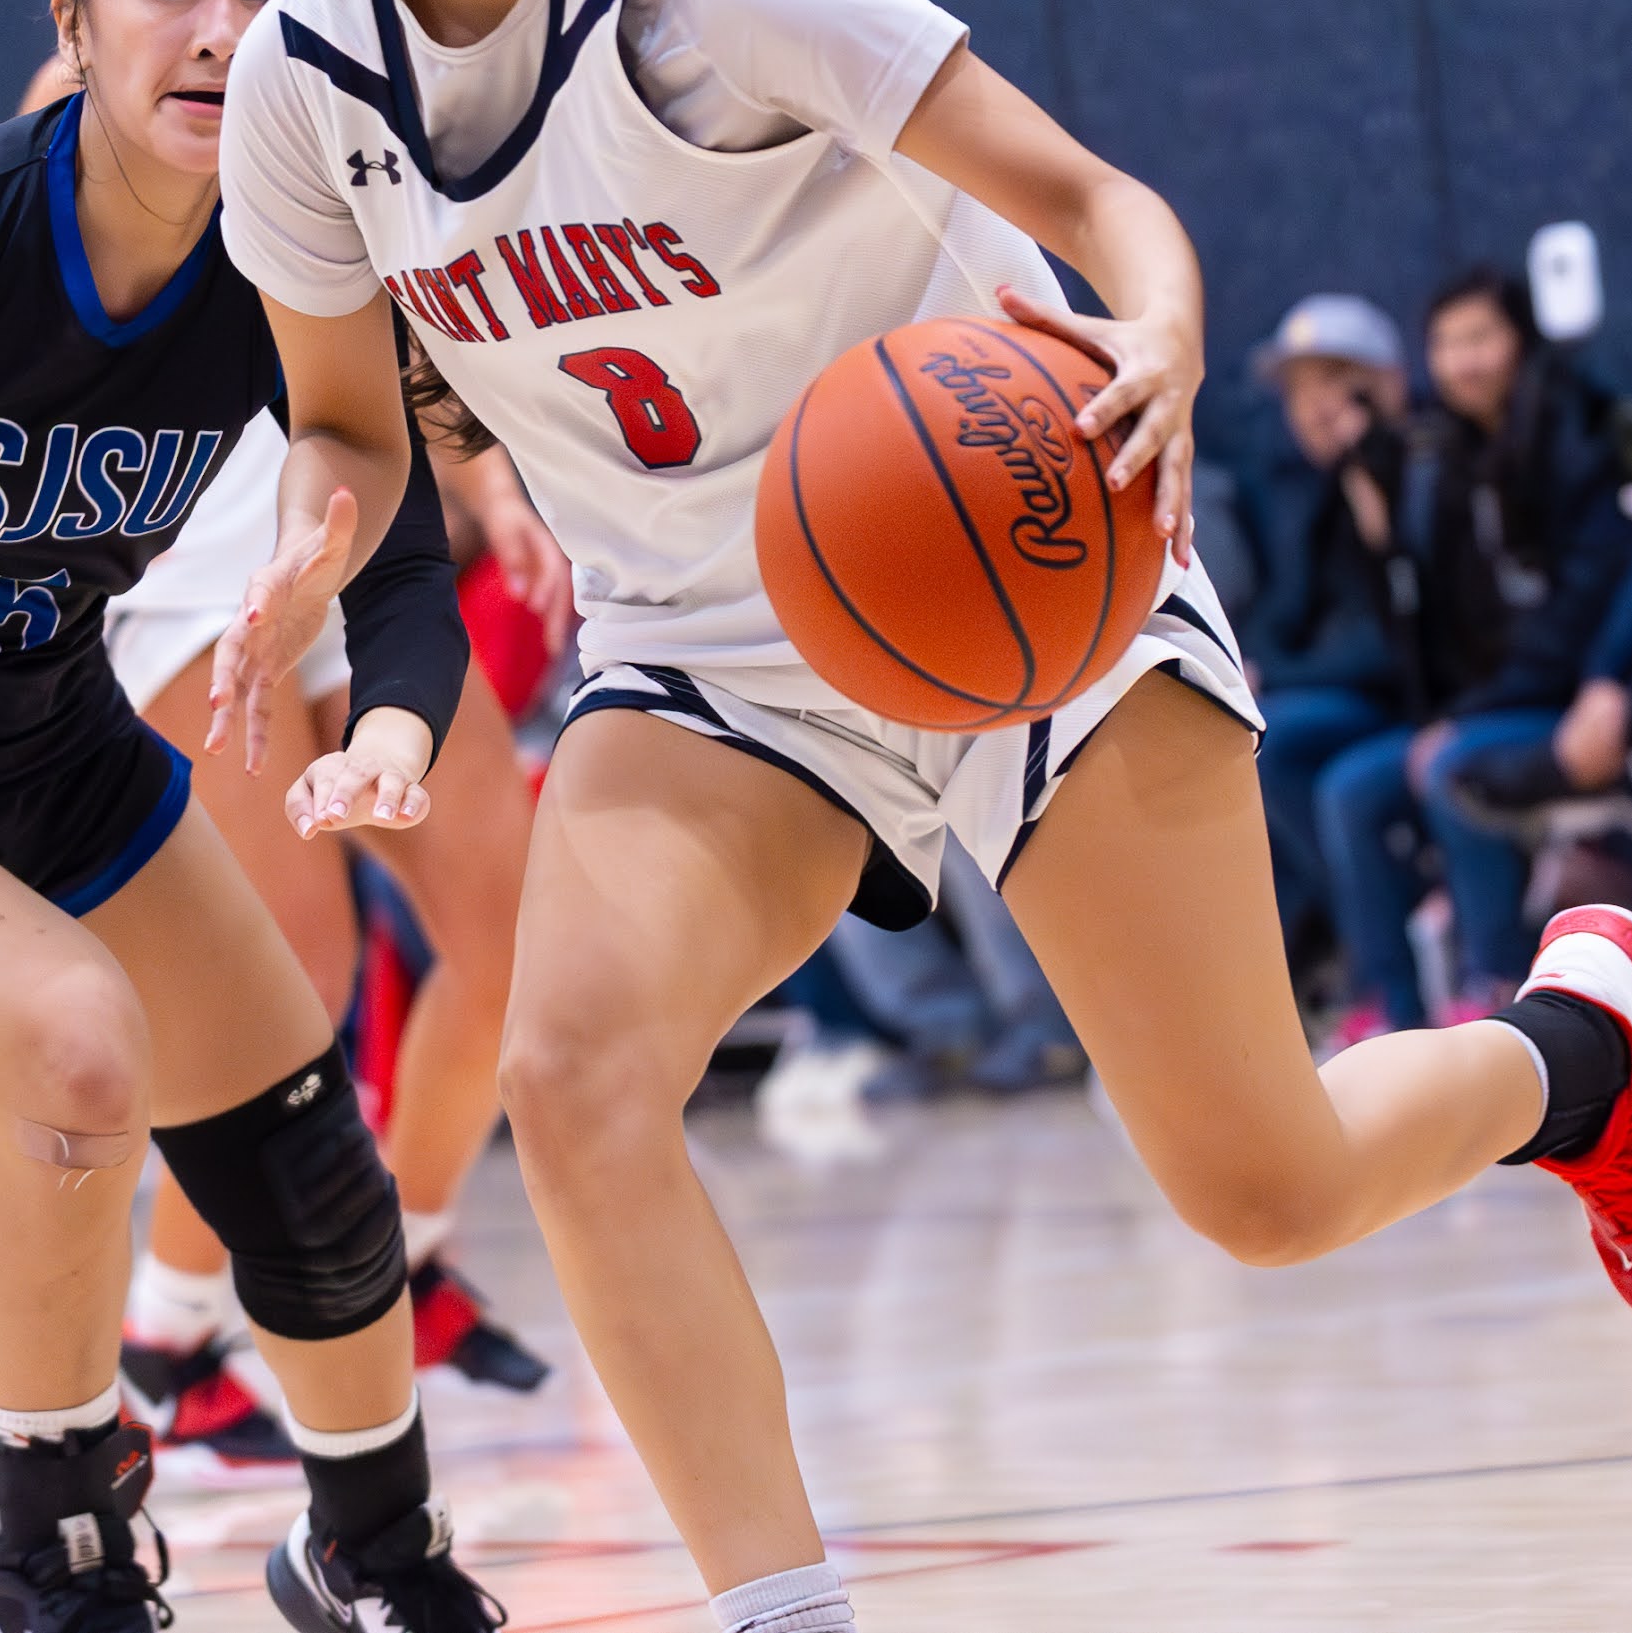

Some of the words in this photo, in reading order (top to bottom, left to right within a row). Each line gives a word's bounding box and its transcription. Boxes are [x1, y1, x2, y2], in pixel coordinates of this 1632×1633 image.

[495, 218, 721, 329] MARY'S
[557, 346, 702, 470] 8
[920, 352, 1088, 570] Rawlings
